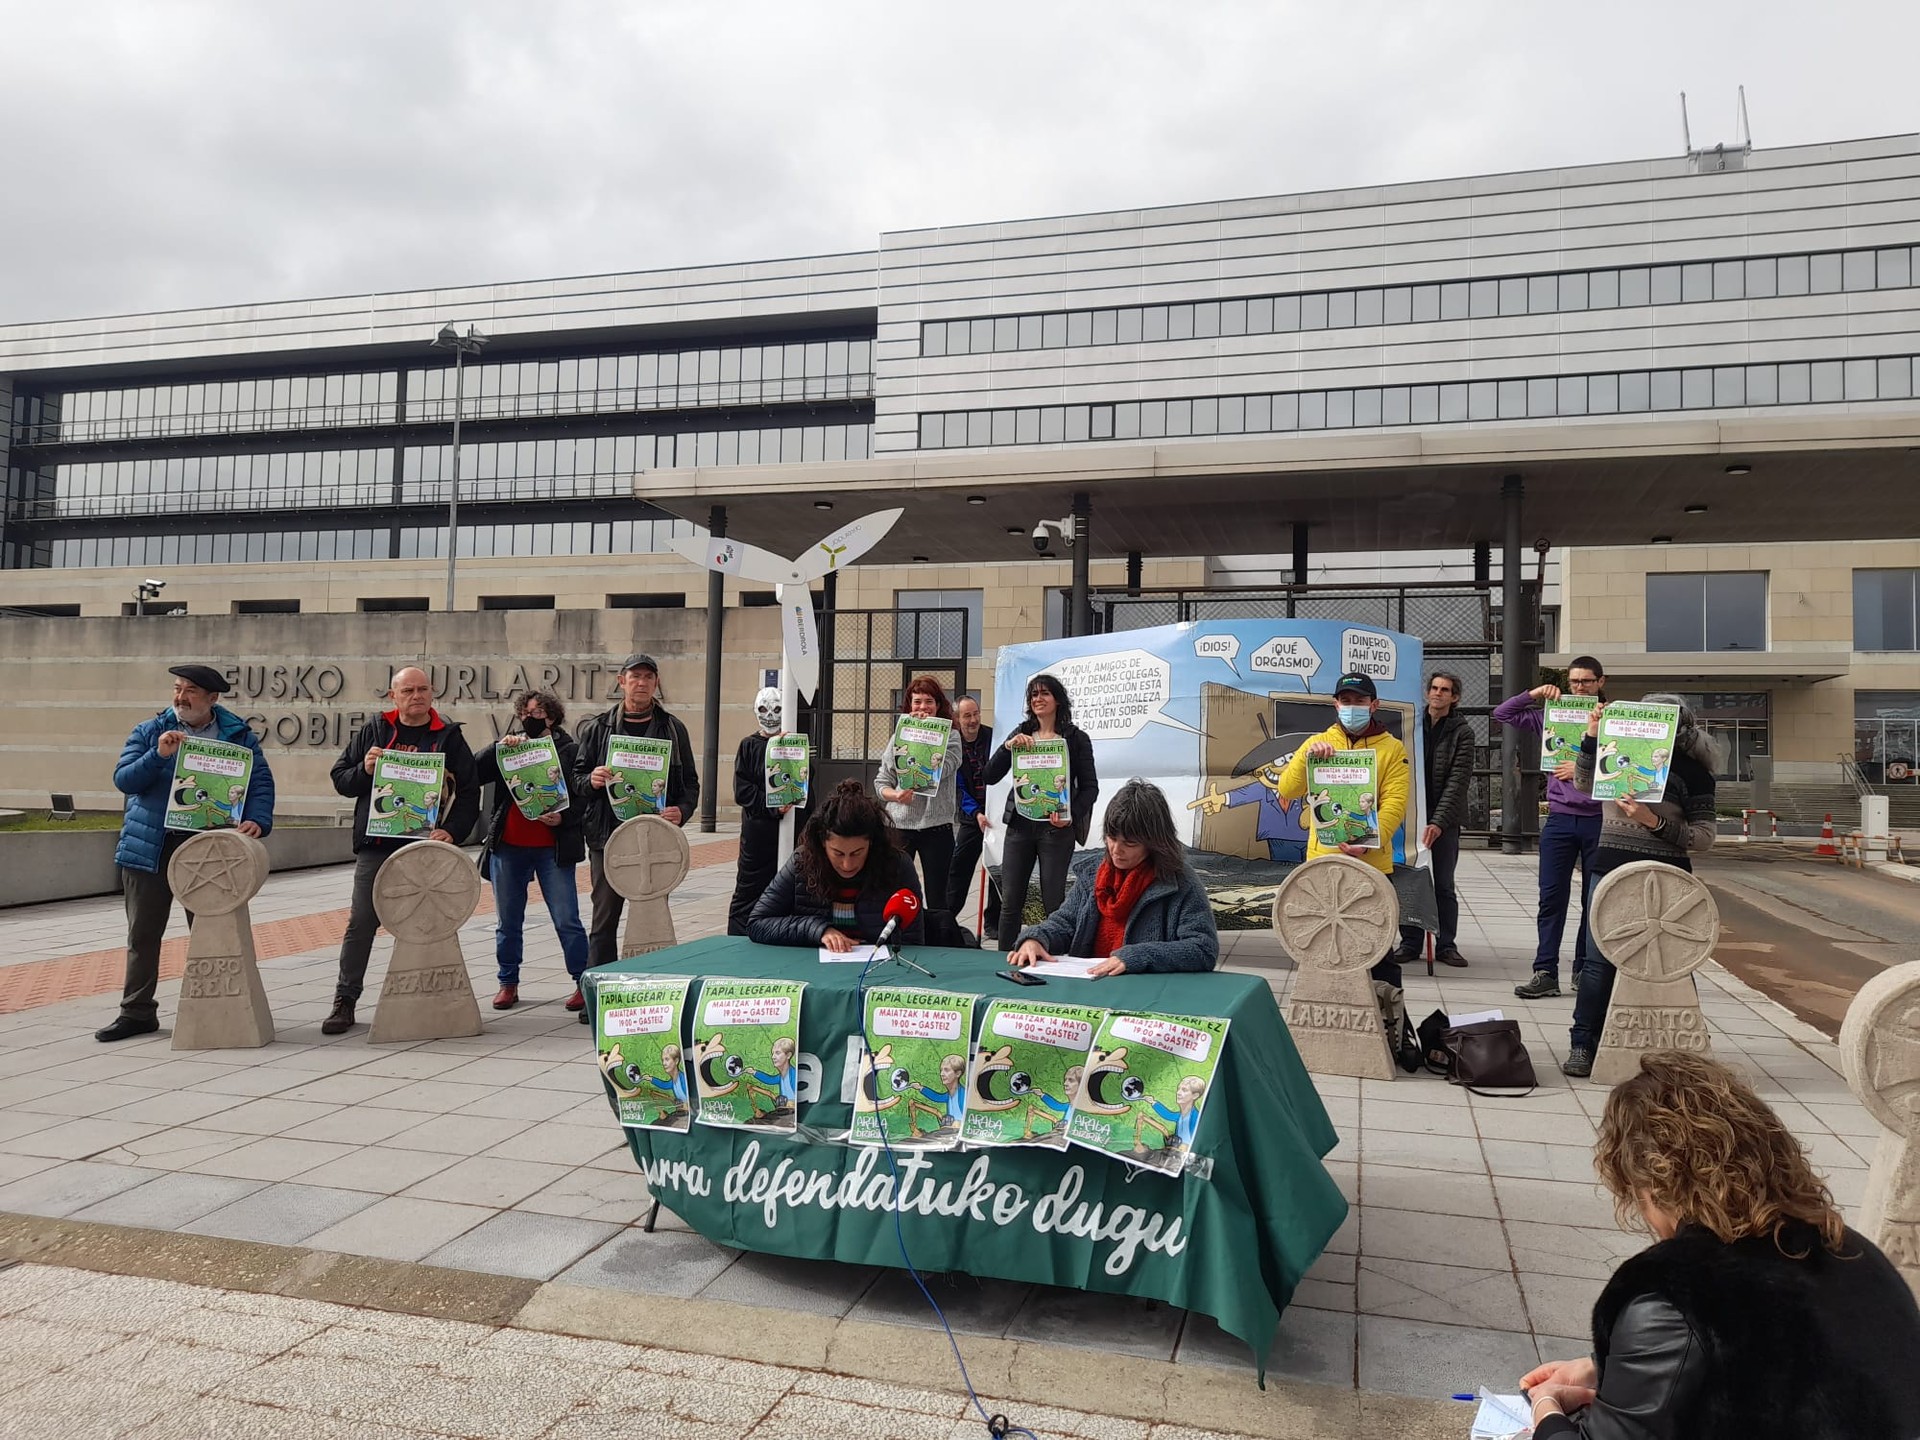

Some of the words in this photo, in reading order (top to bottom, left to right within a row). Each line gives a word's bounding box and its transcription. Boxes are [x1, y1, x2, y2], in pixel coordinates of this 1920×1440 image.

[1200, 641, 1231, 652] ¡DIOS!
[1272, 641, 1298, 656] ¡QUÉ
[1349, 634, 1389, 649] ¡DINERO!
[1349, 647, 1370, 660] ¡AHÍ
[1372, 651, 1391, 662] VEO
[1094, 660, 1127, 672] AMIGOS
[1129, 658, 1141, 668] DE
[1255, 657, 1313, 669] ORGASMO!
[1350, 662, 1390, 676] DINERO!
[1120, 667, 1162, 680] COLEGAS,
[223, 664, 345, 699] EUSKO
[1104, 692, 1161, 706] NATURALEZA
[1083, 705, 1116, 719] ACTÚEN
[1119, 704, 1149, 716] SOBRE
[1604, 709, 1625, 717] TAPIA
[1629, 710, 1662, 720] LEGEARI
[1665, 713, 1675, 721] EZ
[1082, 720, 1095, 731] SU
[1096, 718, 1132, 730] ANTOJO
[183, 743, 205, 753] TAPIA
[241, 752, 250, 760] EZ
[1365, 757, 1373, 765] EZ
[187, 960, 241, 978] GORO
[190, 977, 241, 998] BEL
[705, 987, 734, 996] TAPIA
[740, 985, 782, 995] LEGEARI
[786, 985, 800, 993] EZ
[601, 994, 623, 1006] TAPIA
[627, 991, 666, 1004] LEGEARI
[670, 990, 682, 1001] EZ
[712, 1000, 750, 1008] MAIATZAK
[764, 998, 787, 1006] MAYO
[871, 992, 901, 1002] TAPIA
[907, 993, 951, 1006] LEGEARI
[956, 997, 970, 1007] EZ
[609, 1009, 638, 1018] MAIATZAK
[640, 1007, 646, 1015] 14
[649, 1006, 670, 1014] MAYO
[750, 1007, 780, 1016] GASTEIZ
[879, 1008, 918, 1018] MAIATZAK
[922, 1010, 929, 1018] 14
[932, 1012, 957, 1020] MAYO
[995, 1002, 1028, 1011] TAPIA
[1034, 1005, 1081, 1016] LEGEARI
[1086, 1009, 1101, 1020] EZ
[1287, 1004, 1379, 1032] LABRAZA
[639, 1016, 663, 1025] GASTEIZ
[918, 1020, 950, 1030] GASTEIZ
[1002, 1012, 1045, 1024] MAIATZAK
[1061, 1020, 1088, 1032] MAYO
[1612, 1008, 1697, 1029] CANTO
[1045, 1027, 1080, 1041] GASTEIZ
[1121, 1017, 1164, 1029] MAIATZAK
[1168, 1024, 1177, 1033] 14
[1180, 1027, 1208, 1042] MAYO
[1207, 1021, 1222, 1033] EZ
[1163, 1033, 1199, 1051] GASTEIZ
[1603, 1029, 1707, 1052] BLANCO
[723, 1140, 1029, 1229] defendatuko
[1032, 1165, 1187, 1277] dugu
